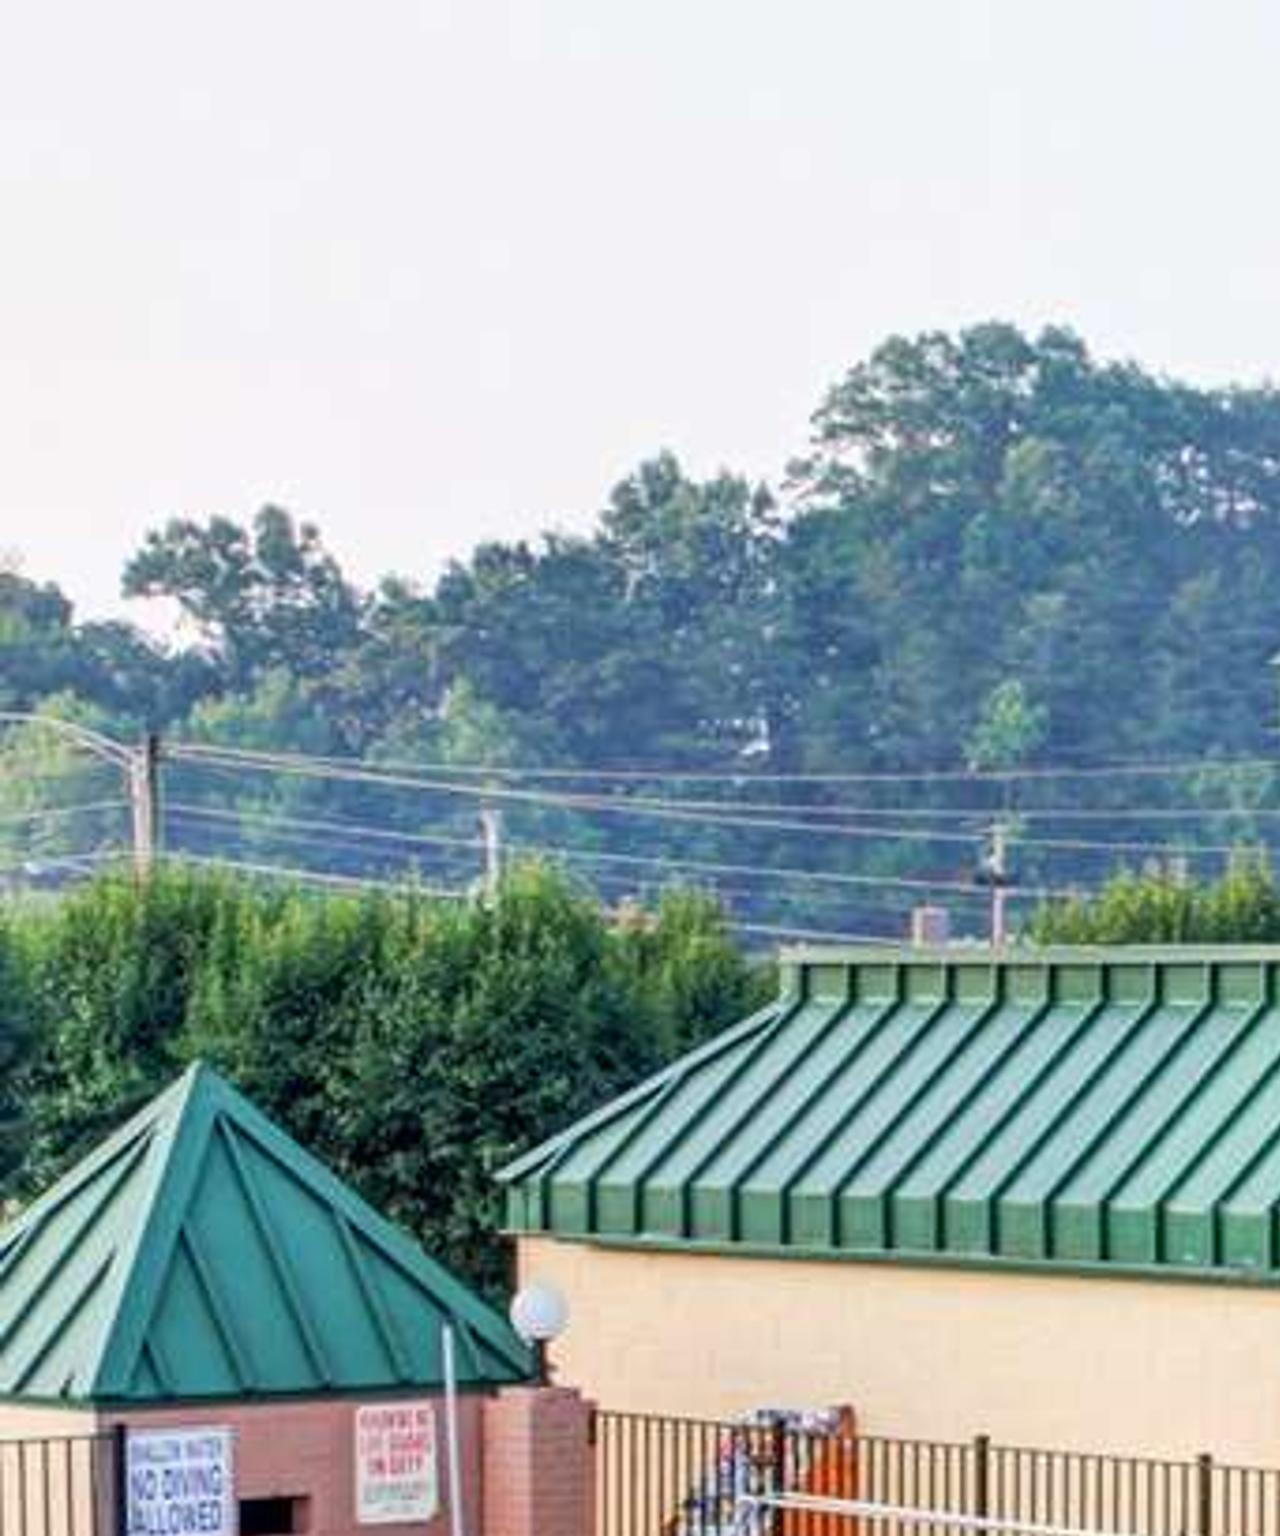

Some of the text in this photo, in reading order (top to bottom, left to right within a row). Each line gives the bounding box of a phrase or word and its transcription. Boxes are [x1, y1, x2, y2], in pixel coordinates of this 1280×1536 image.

[131, 1465, 222, 1500] NO DIVING
[130, 1500, 222, 1536] ALLOWED
